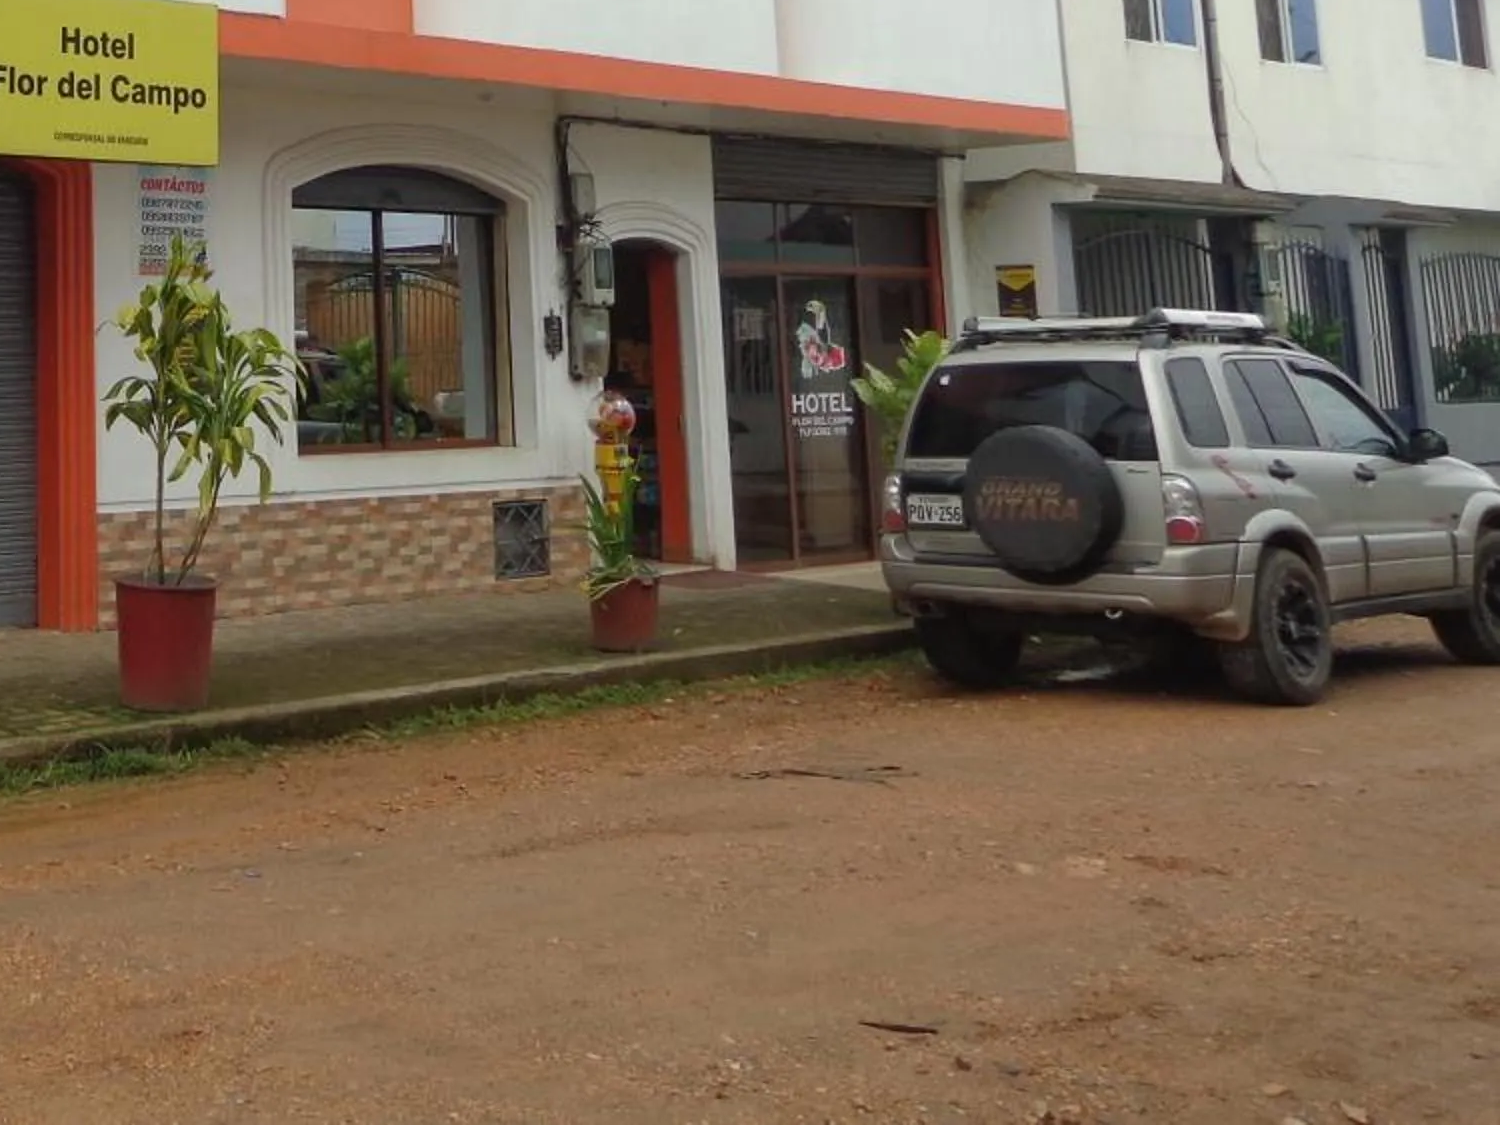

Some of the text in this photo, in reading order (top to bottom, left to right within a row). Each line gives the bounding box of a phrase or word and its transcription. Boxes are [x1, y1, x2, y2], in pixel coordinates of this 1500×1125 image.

[60, 26, 135, 60] Hotel
[57, 70, 101, 101] del
[110, 74, 207, 114] Campo
[791, 392, 854, 414] HOTEL
[975, 496, 1081, 522] VITARA
